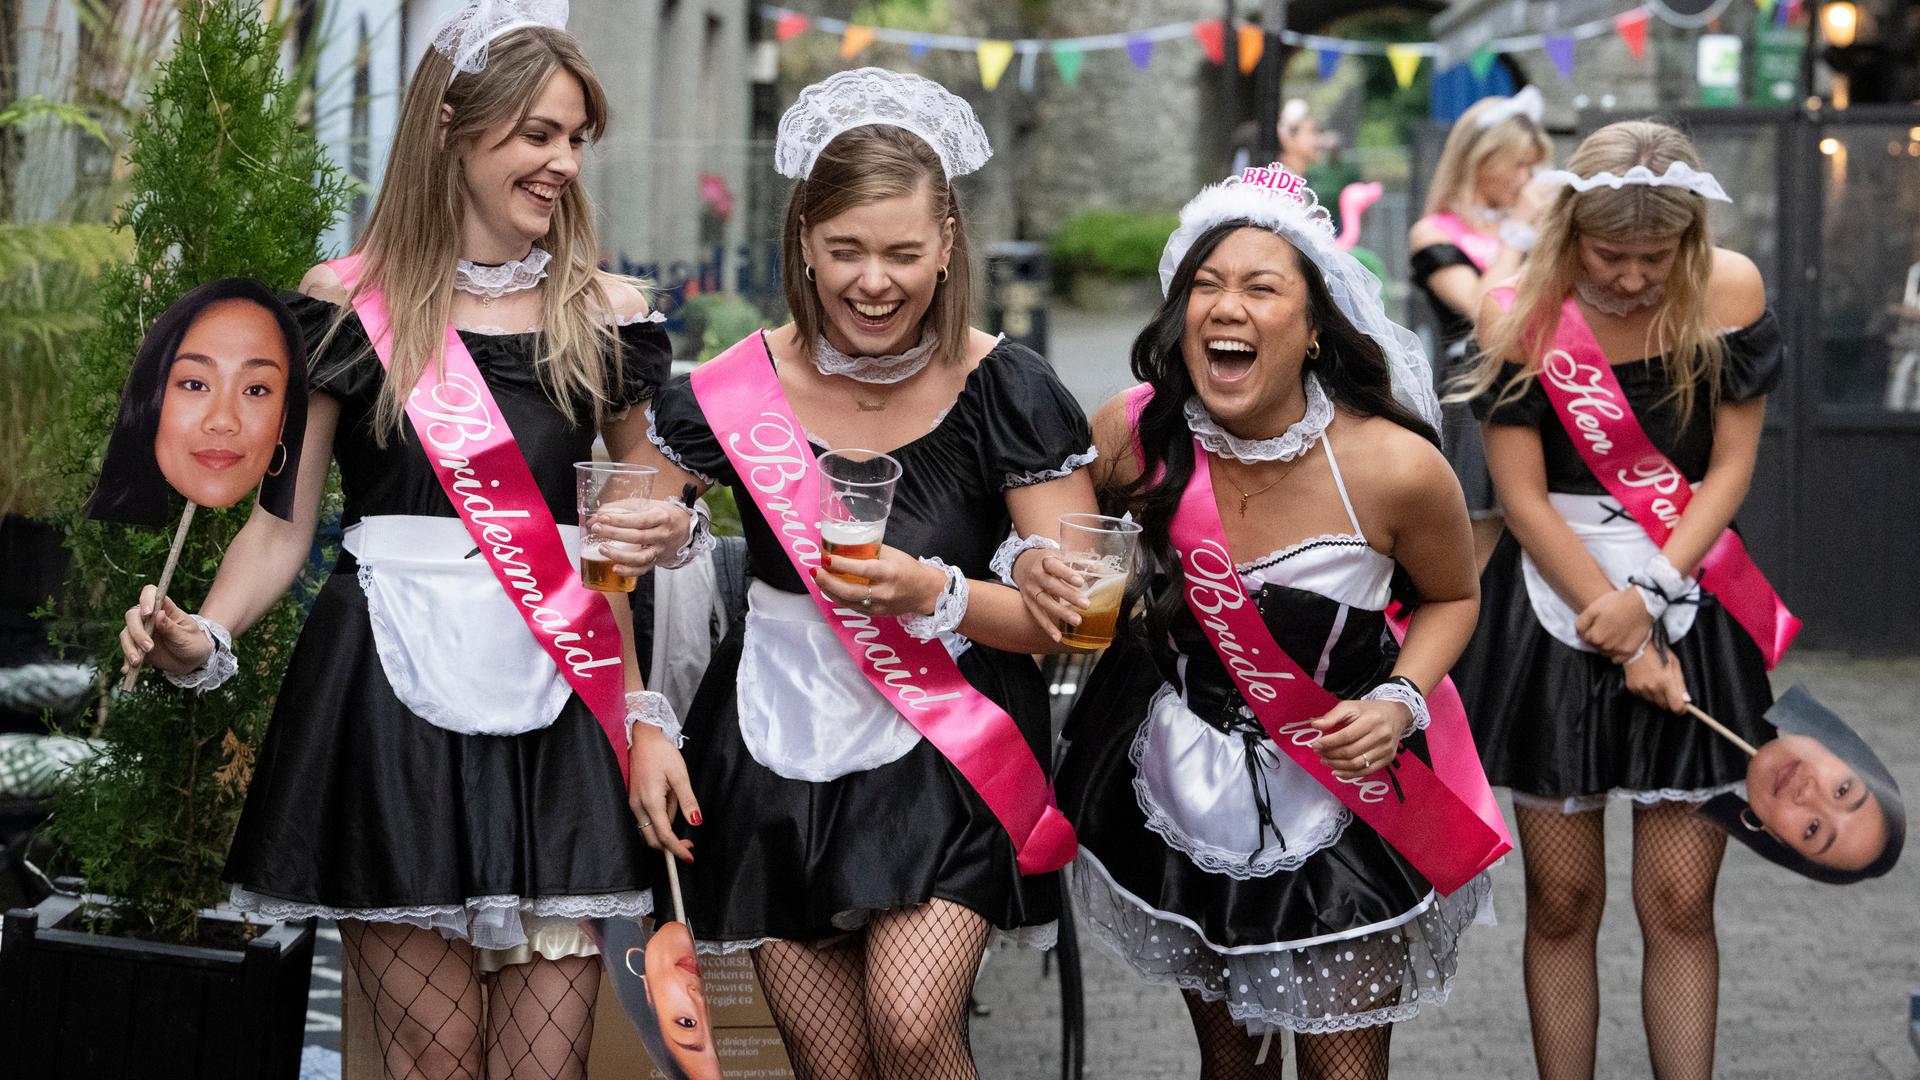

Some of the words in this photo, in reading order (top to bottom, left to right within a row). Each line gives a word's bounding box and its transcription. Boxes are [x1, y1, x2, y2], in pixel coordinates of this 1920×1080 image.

[1241, 168, 1305, 195] BRIDE
[1543, 349, 1623, 456] Hen
[409, 373, 622, 678] Bridesmaid
[729, 411, 961, 711] Bridmaid
[1176, 539, 1296, 703] Bride
[705, 983, 737, 992] Prawn
